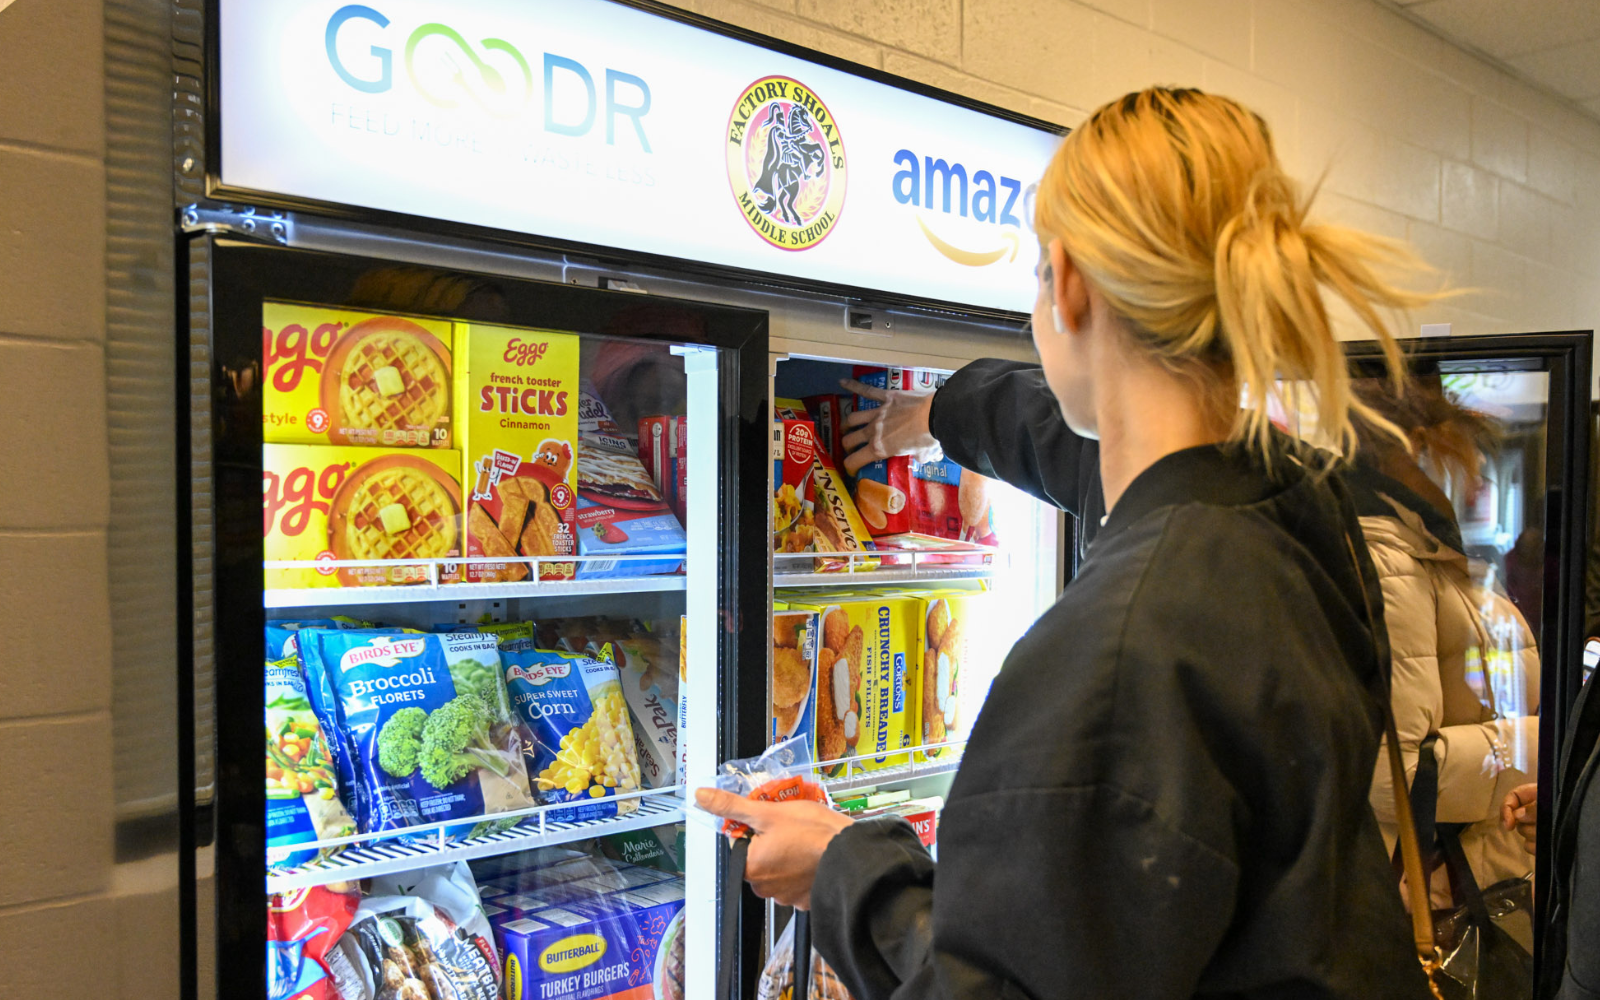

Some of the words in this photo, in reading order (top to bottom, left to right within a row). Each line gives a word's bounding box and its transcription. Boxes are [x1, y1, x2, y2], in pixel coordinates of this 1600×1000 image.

[324, 4, 653, 154] GOODR
[730, 81, 788, 147] FACTORY
[792, 86, 844, 170] SHOALS
[892, 149, 1038, 234] amaz
[738, 190, 787, 244] MIDDLE
[790, 210, 836, 245] SCHOOL
[503, 337, 549, 367] Eggo
[490, 372, 524, 385] french
[526, 375, 562, 388] toaster
[263, 412, 298, 425] style
[312, 414, 324, 428] 9
[499, 417, 551, 431] Cinnamon
[434, 428, 448, 440] 10
[788, 433, 813, 447] PROTEIN
[795, 427, 809, 438] 20g
[263, 461, 350, 537] ggo
[557, 490, 566, 503] 9
[577, 508, 616, 520] strawberry
[827, 493, 858, 551] Serve
[557, 522, 570, 534] 32
[443, 562, 457, 573] 10
[449, 645, 473, 653] COOKS
[877, 606, 890, 683] CRUNCHY
[349, 646, 392, 665] BIRDS
[393, 641, 418, 655] EYE
[347, 666, 437, 697] Broccoli
[513, 667, 544, 681] BIRDS
[545, 666, 567, 676] EYE
[370, 689, 426, 706] FLORETS
[514, 692, 546, 705] SUPER
[546, 689, 579, 699] SWEET
[528, 701, 576, 720] Corn
[902, 733, 911, 747] 6
[622, 839, 657, 856] Marie
[625, 848, 665, 863] Callender's
[636, 935, 658, 949] Tasty
[546, 943, 600, 964] BUTTERBALL
[461, 937, 499, 1000] MEATBA
[540, 974, 582, 999] TURKEY
[583, 962, 630, 988] BURGERS
